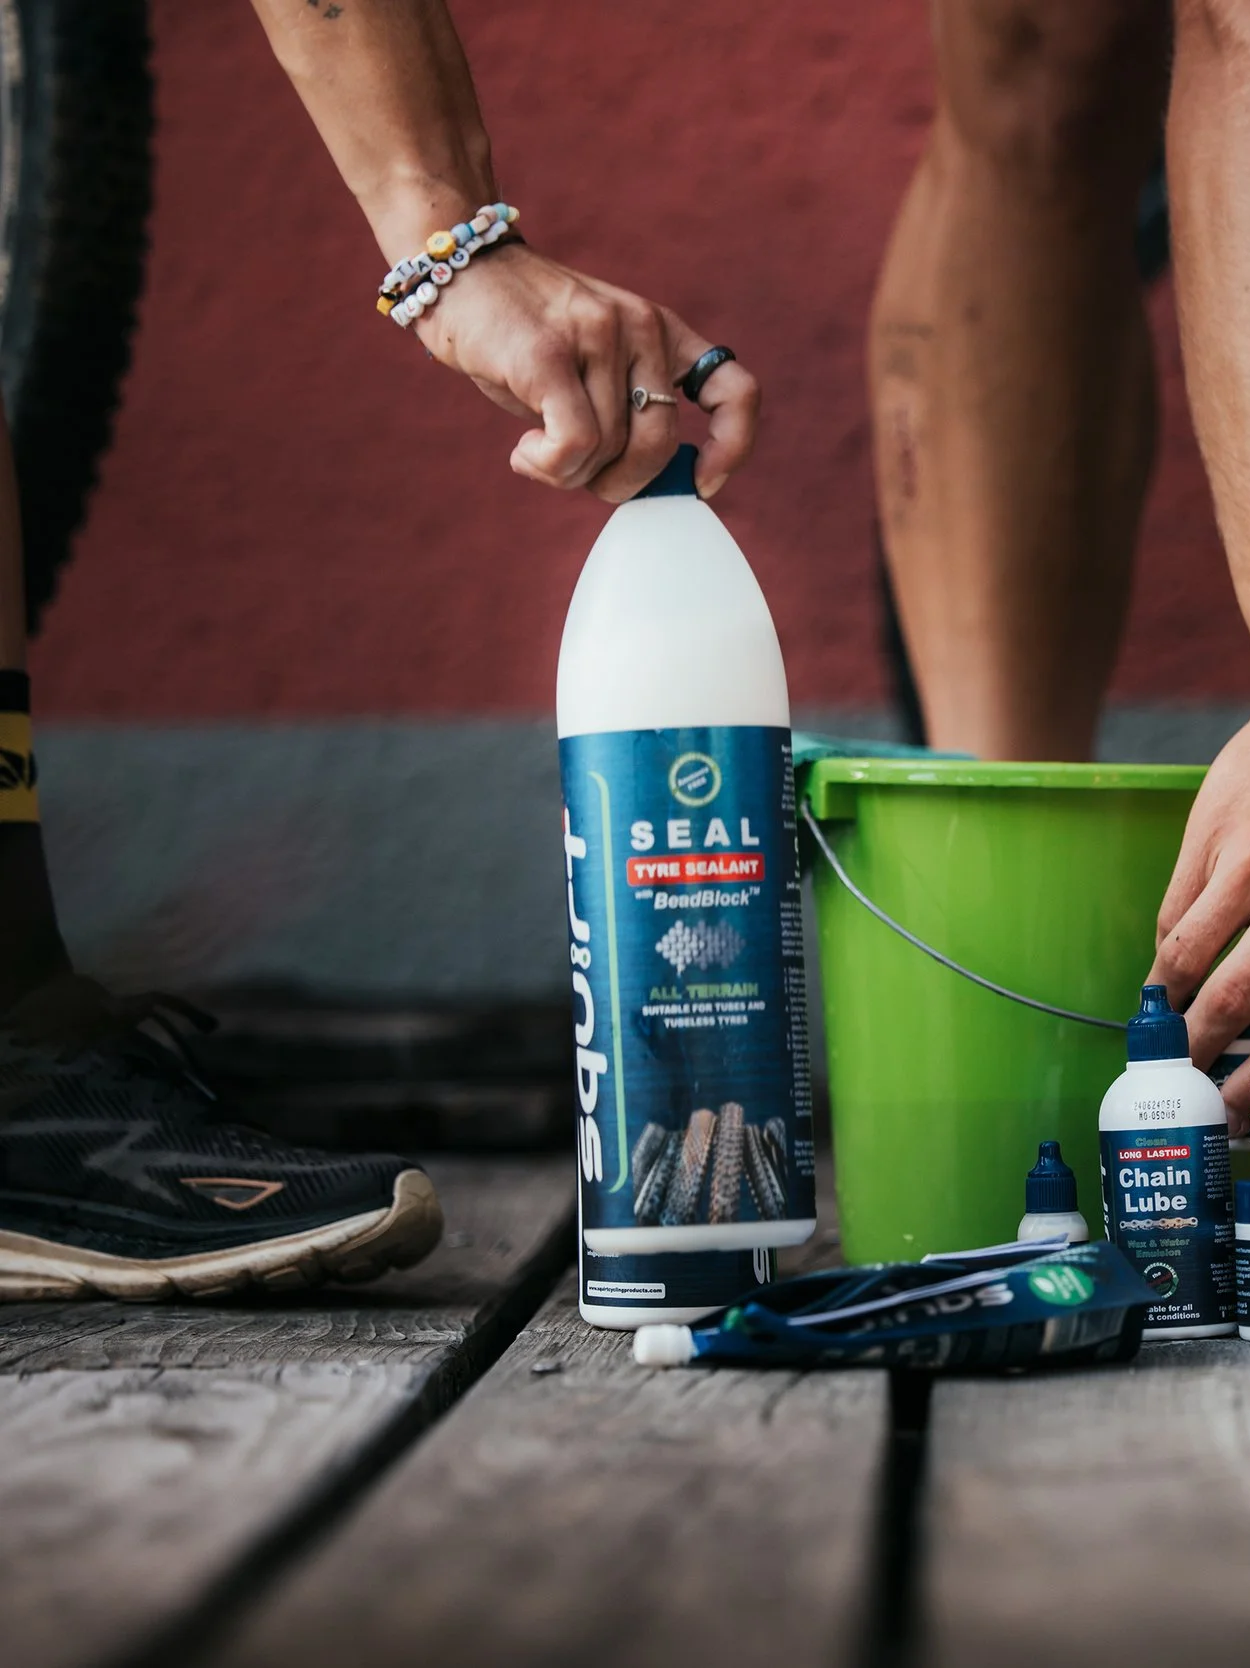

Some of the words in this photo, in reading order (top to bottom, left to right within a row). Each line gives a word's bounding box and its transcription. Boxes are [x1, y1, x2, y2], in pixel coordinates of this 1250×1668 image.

[630, 817, 760, 851] SEAL
[634, 862, 681, 879] TYRE
[685, 860, 759, 877] SEALANT
[562, 807, 607, 1183] squirt
[650, 985, 682, 1000] ALL
[686, 982, 759, 999] TERRAIN
[642, 1003, 690, 1017] SUITABLE
[692, 1002, 713, 1013] FOR
[715, 1001, 746, 1013] TUBES
[748, 1000, 766, 1011] AND
[664, 1016, 716, 1029] TUBELESS
[718, 1015, 748, 1026] TYRES
[1135, 1137, 1167, 1147] Clean
[1119, 1151, 1142, 1160] LONG
[1147, 1148, 1188, 1159] LASTING
[1119, 1166, 1191, 1188] Chain
[1124, 1191, 1187, 1213] Lube
[1128, 1240, 1147, 1249] Wax
[1149, 1240, 1157, 1248] &
[1160, 1238, 1190, 1248] Water
[1135, 1249, 1181, 1259] Emulsion
[1168, 1304, 1180, 1312] for
[1182, 1303, 1193, 1311] all
[1148, 1313, 1155, 1321] &
[1156, 1312, 1201, 1321] conditions
